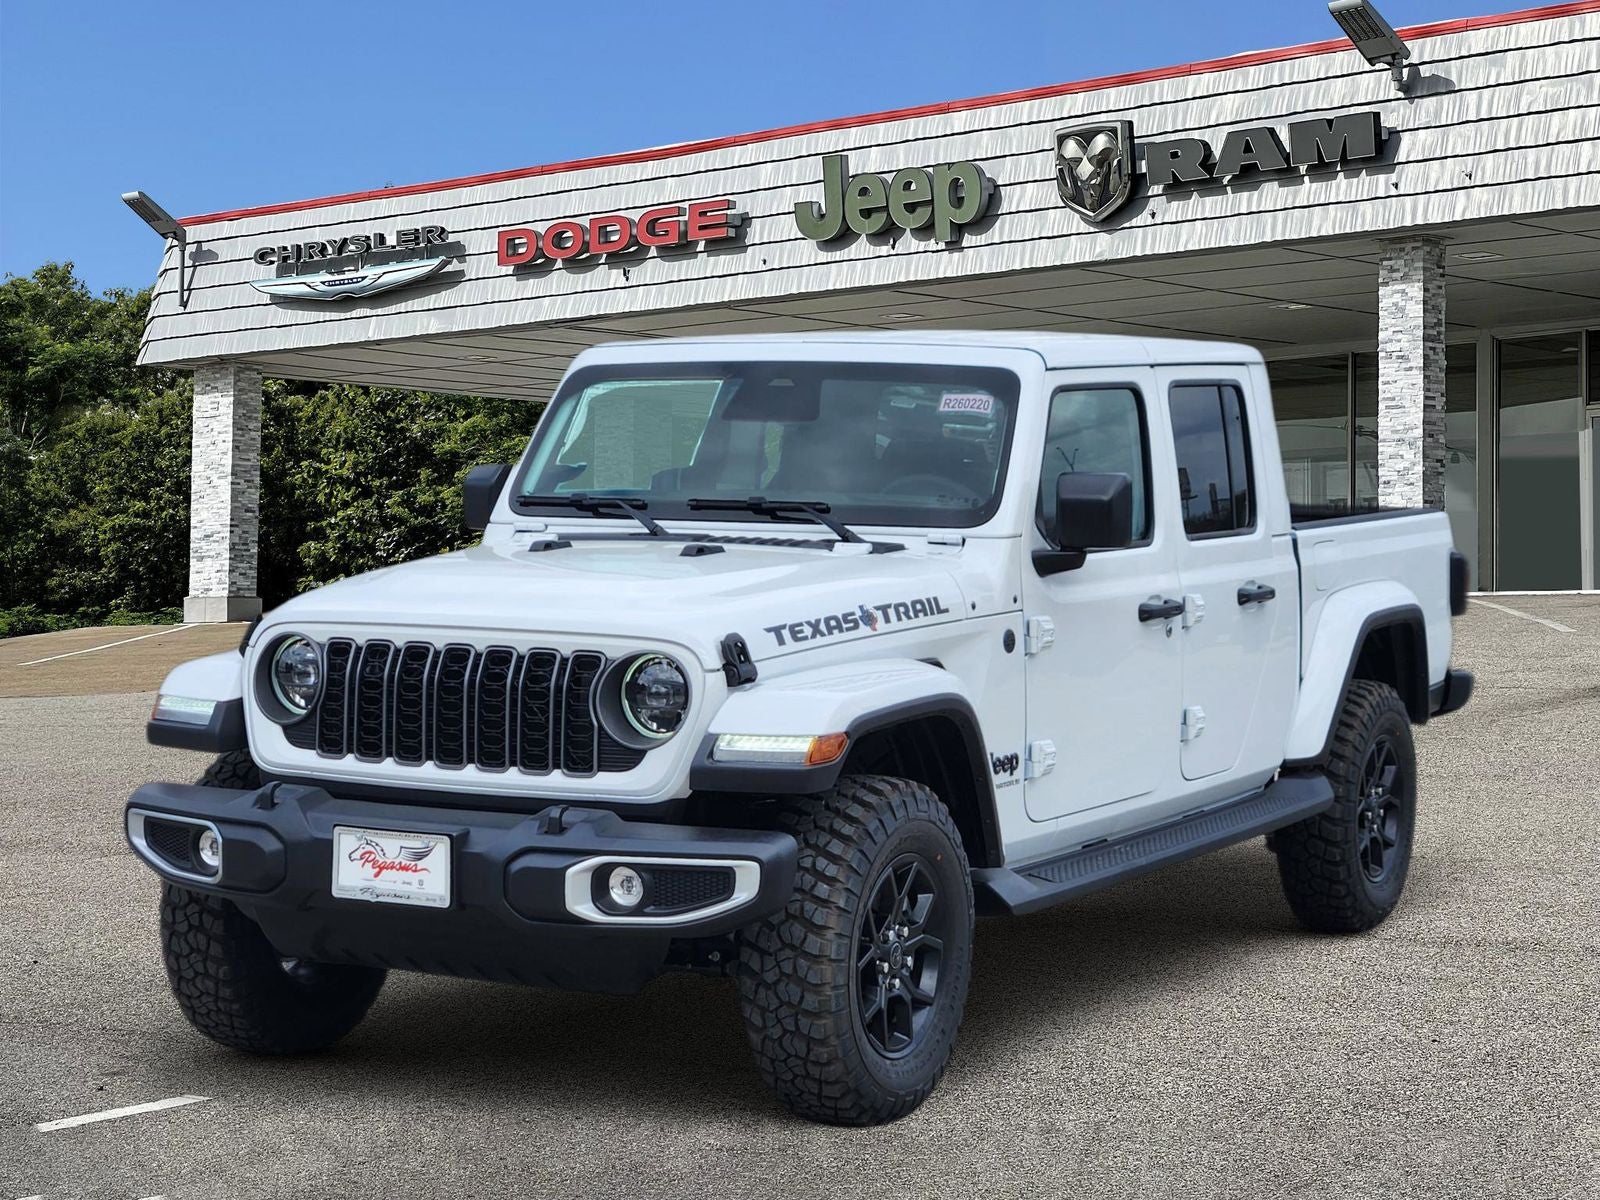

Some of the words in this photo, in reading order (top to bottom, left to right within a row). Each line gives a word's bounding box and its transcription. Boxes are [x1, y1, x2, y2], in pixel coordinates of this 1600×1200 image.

[1144, 111, 1379, 186] RAM
[794, 154, 987, 242] Jeep
[253, 225, 446, 266] CHRYSLER
[497, 199, 733, 266] DODGE
[942, 398, 990, 411] R260220
[764, 610, 860, 647] TEXAS
[873, 596, 949, 624] TRAIL
[360, 850, 431, 878] Pegasus
